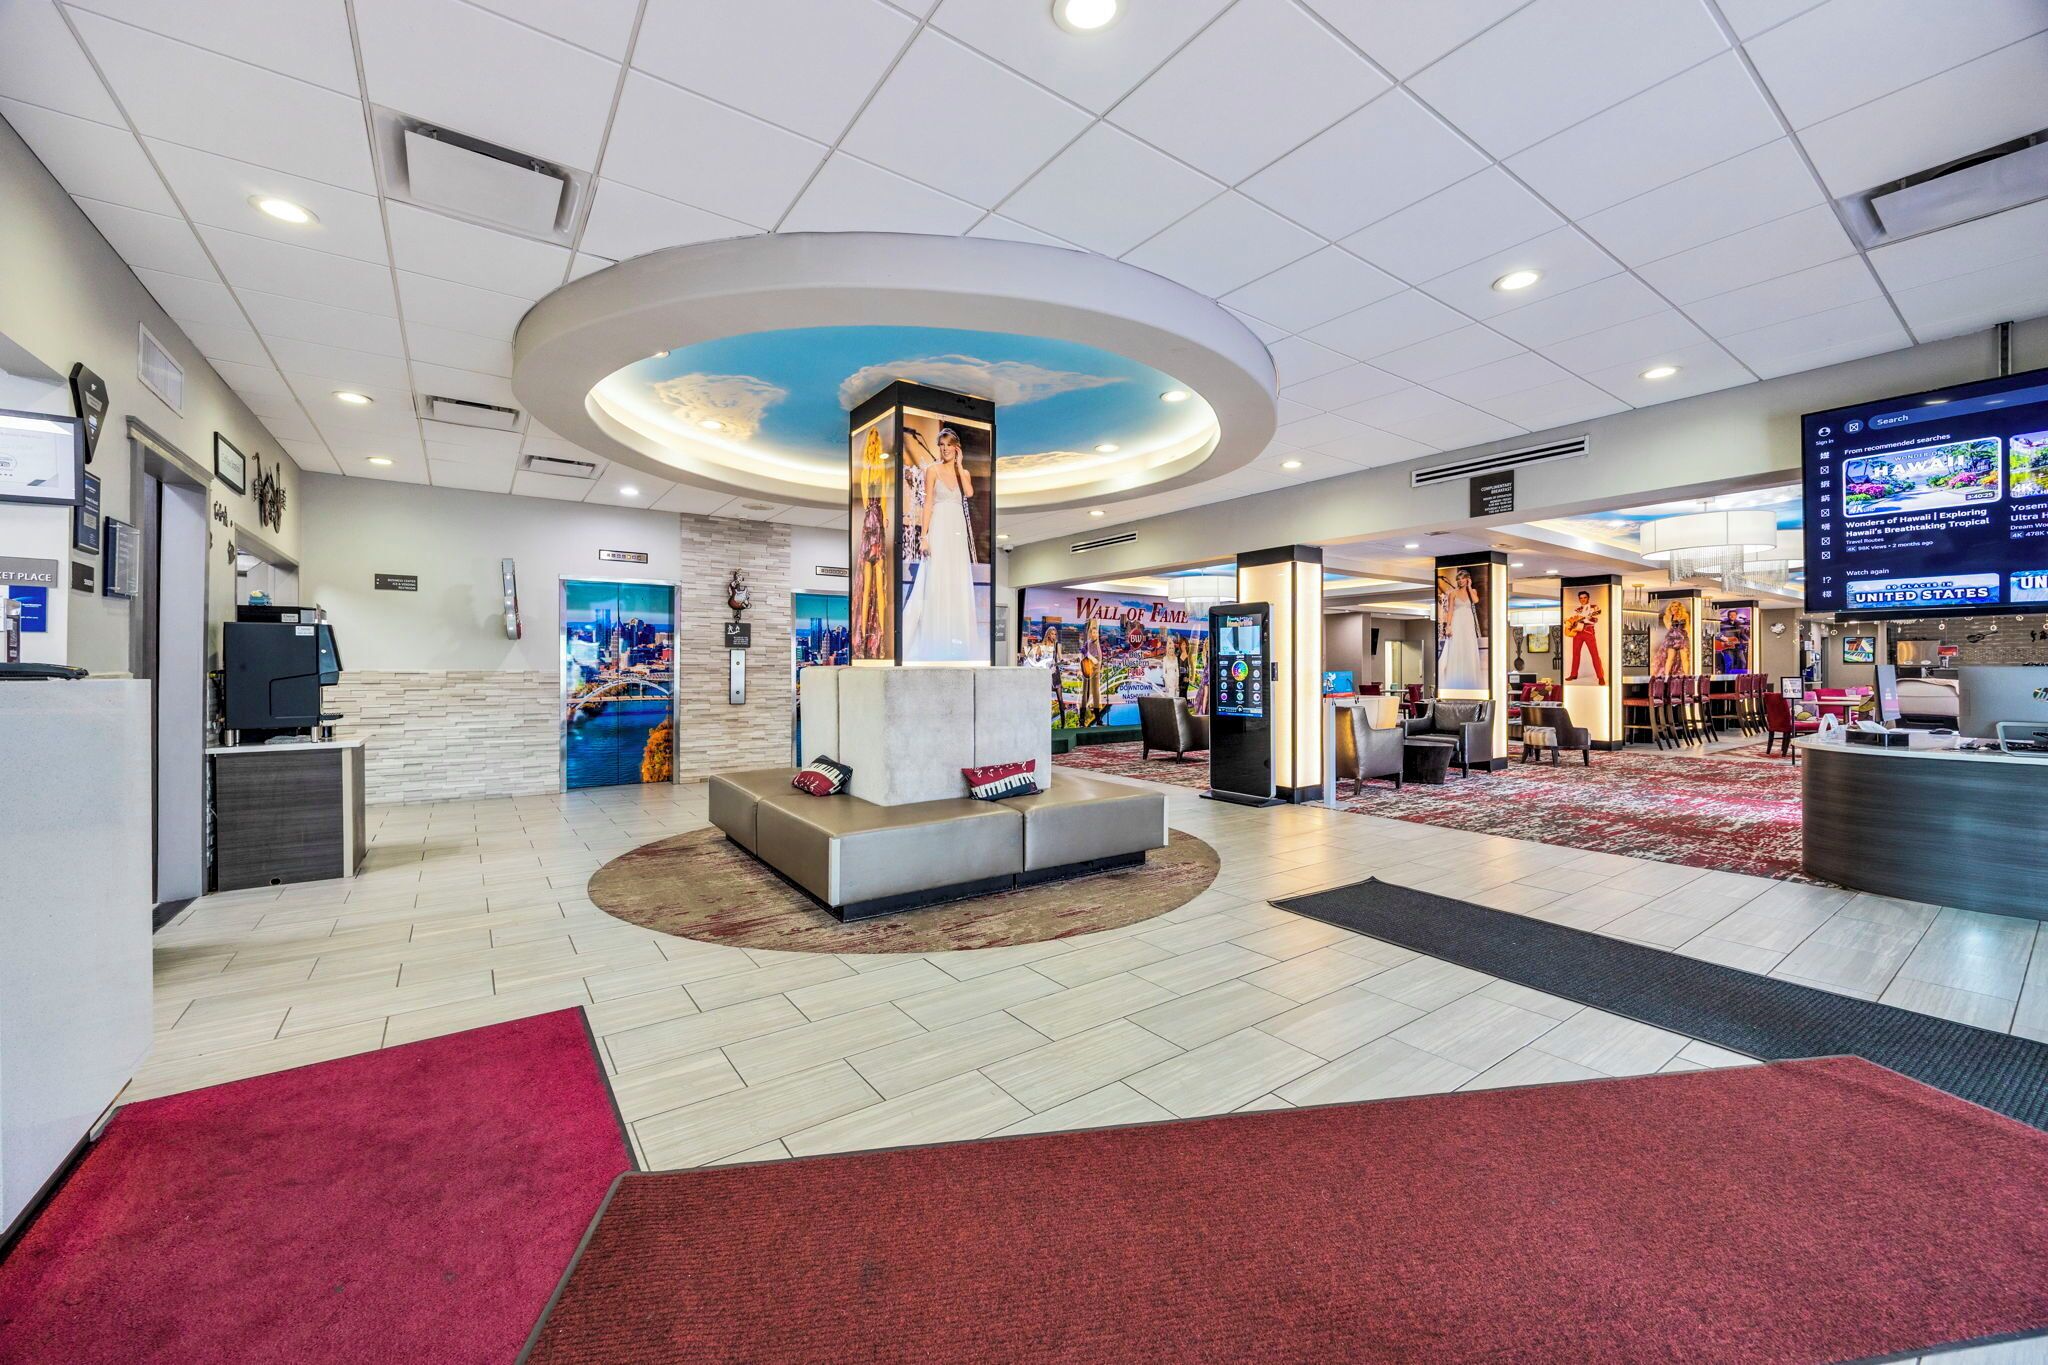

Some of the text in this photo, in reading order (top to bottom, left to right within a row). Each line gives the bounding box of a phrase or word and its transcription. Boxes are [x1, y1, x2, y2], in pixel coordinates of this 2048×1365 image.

[1877, 414, 1909, 426] Search
[1844, 434, 1951, 456] From recommended searches
[1873, 455, 1966, 477] HAWAII
[1845, 519, 1885, 528] Wonders
[1887, 516, 1897, 525] of
[1899, 513, 1931, 523] Hawaii
[1940, 508, 1987, 520] Exploring
[2010, 513, 2038, 522] Ultra
[1845, 517, 1990, 537] Hawaii's Breathtaking Tropical
[17, 572, 52, 582] PLACE
[1846, 567, 1890, 577] Watch again
[1856, 587, 1989, 603] UNITED STATES
[1076, 597, 1189, 624] WALL OF FAME
[1130, 634, 1143, 643] BW
